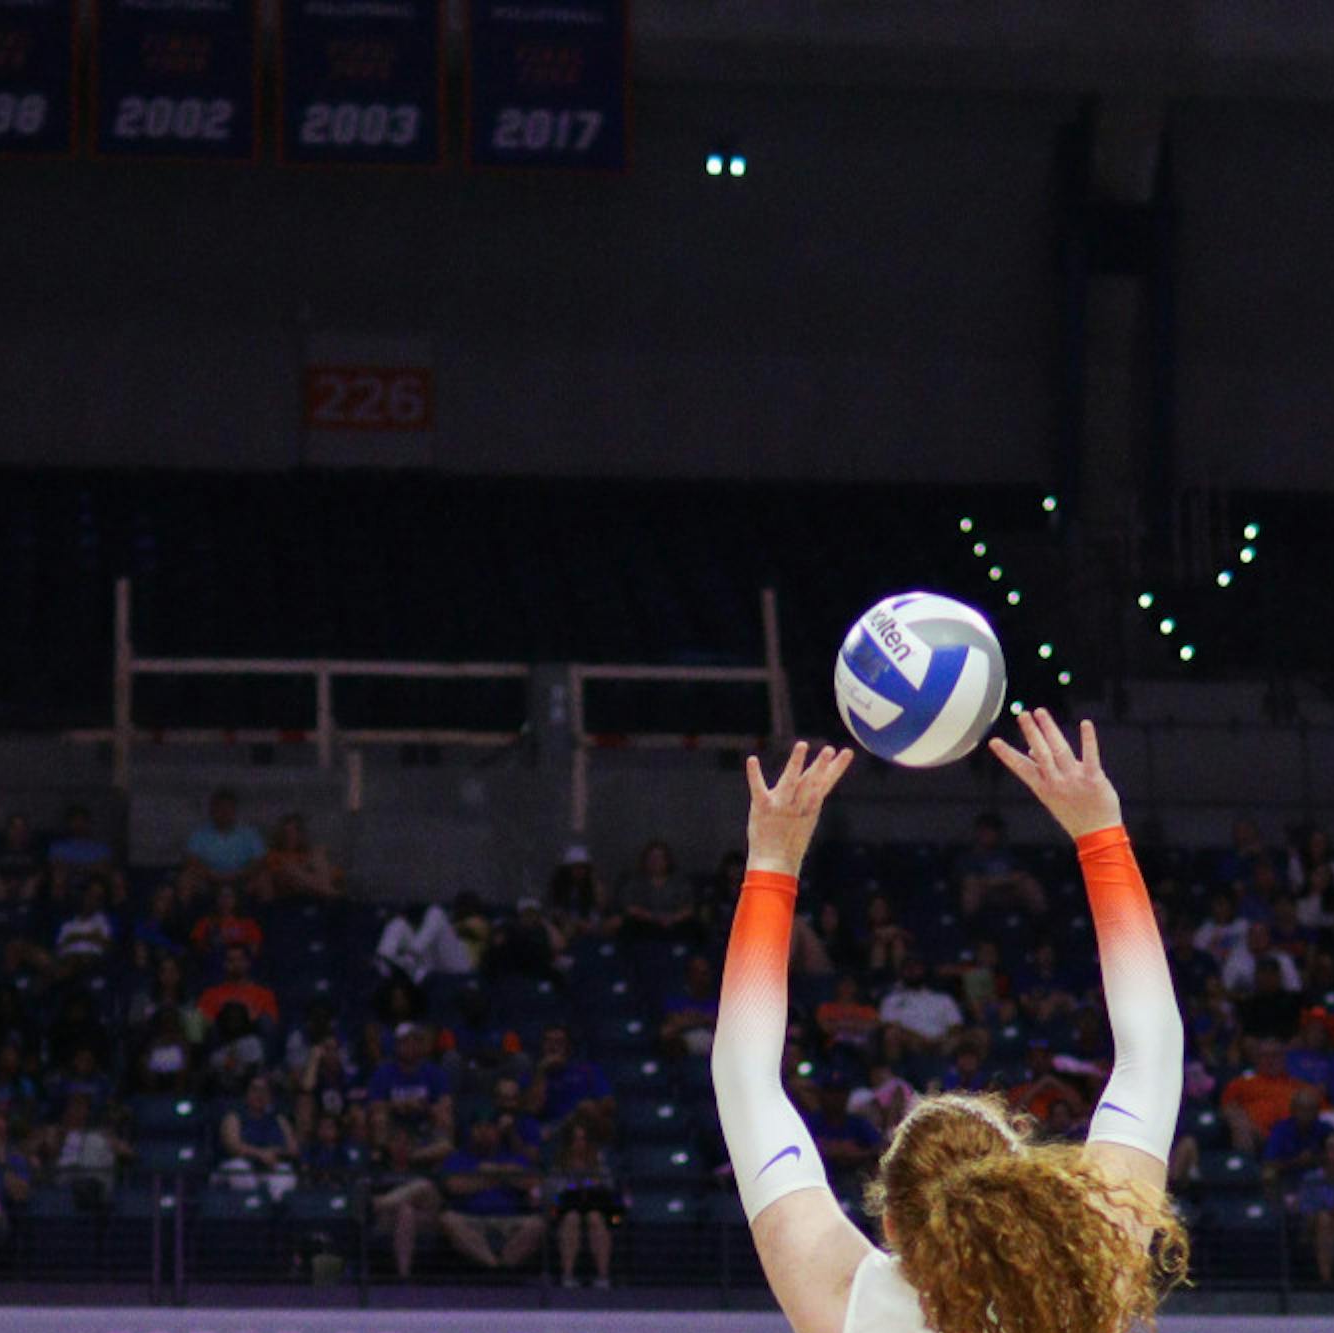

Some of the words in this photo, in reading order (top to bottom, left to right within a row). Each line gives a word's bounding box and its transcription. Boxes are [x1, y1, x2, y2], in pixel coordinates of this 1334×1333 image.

[113, 96, 234, 141] 2002
[299, 102, 419, 147] 2003
[491, 108, 604, 151] 2017
[314, 374, 425, 422] 226
[869, 608, 912, 664] olten
